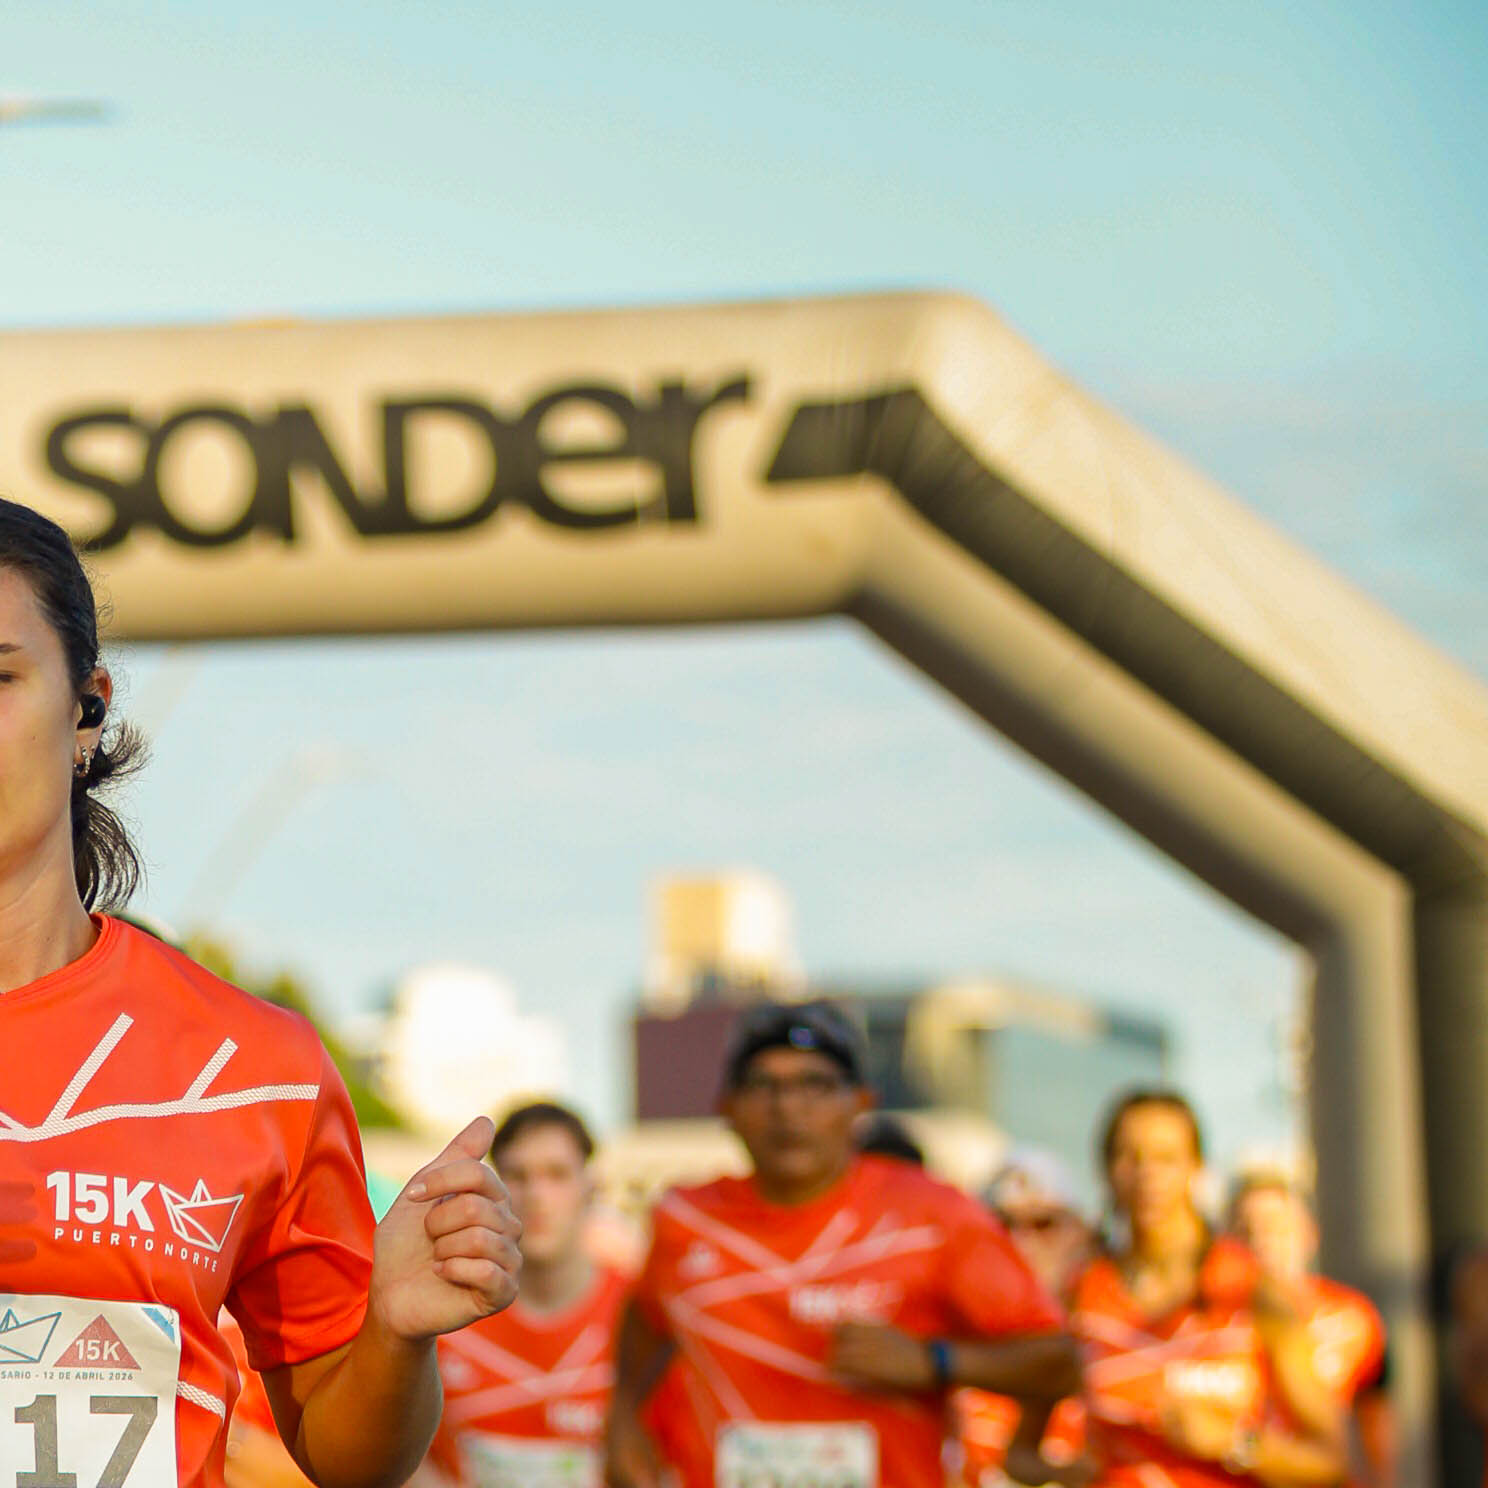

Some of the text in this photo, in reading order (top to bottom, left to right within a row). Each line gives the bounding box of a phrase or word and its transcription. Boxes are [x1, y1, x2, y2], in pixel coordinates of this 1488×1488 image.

[46, 1170, 155, 1232] 15K
[55, 1227, 217, 1273] PUERTO NORTE
[75, 1338, 121, 1362] 15K
[44, 1372, 55, 1381] 12
[59, 1372, 71, 1381] DE
[75, 1372, 105, 1381] ABRIL
[109, 1372, 134, 1381] 2026
